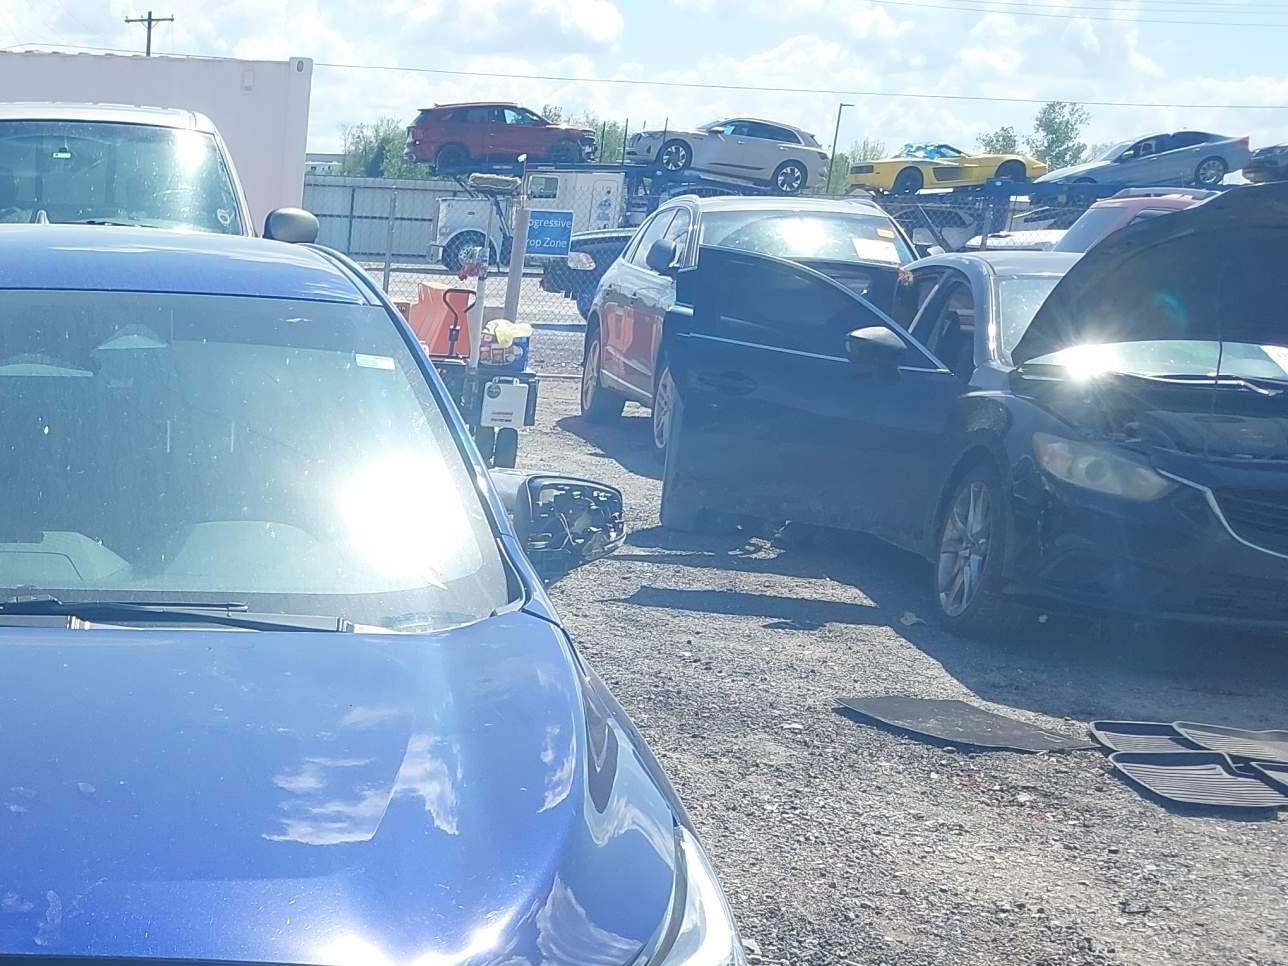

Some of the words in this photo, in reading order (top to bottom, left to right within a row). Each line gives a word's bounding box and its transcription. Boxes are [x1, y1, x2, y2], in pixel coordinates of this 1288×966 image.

[528, 218, 572, 229] ogressive
[526, 239, 542, 249] rop
[543, 237, 567, 248] Zone
